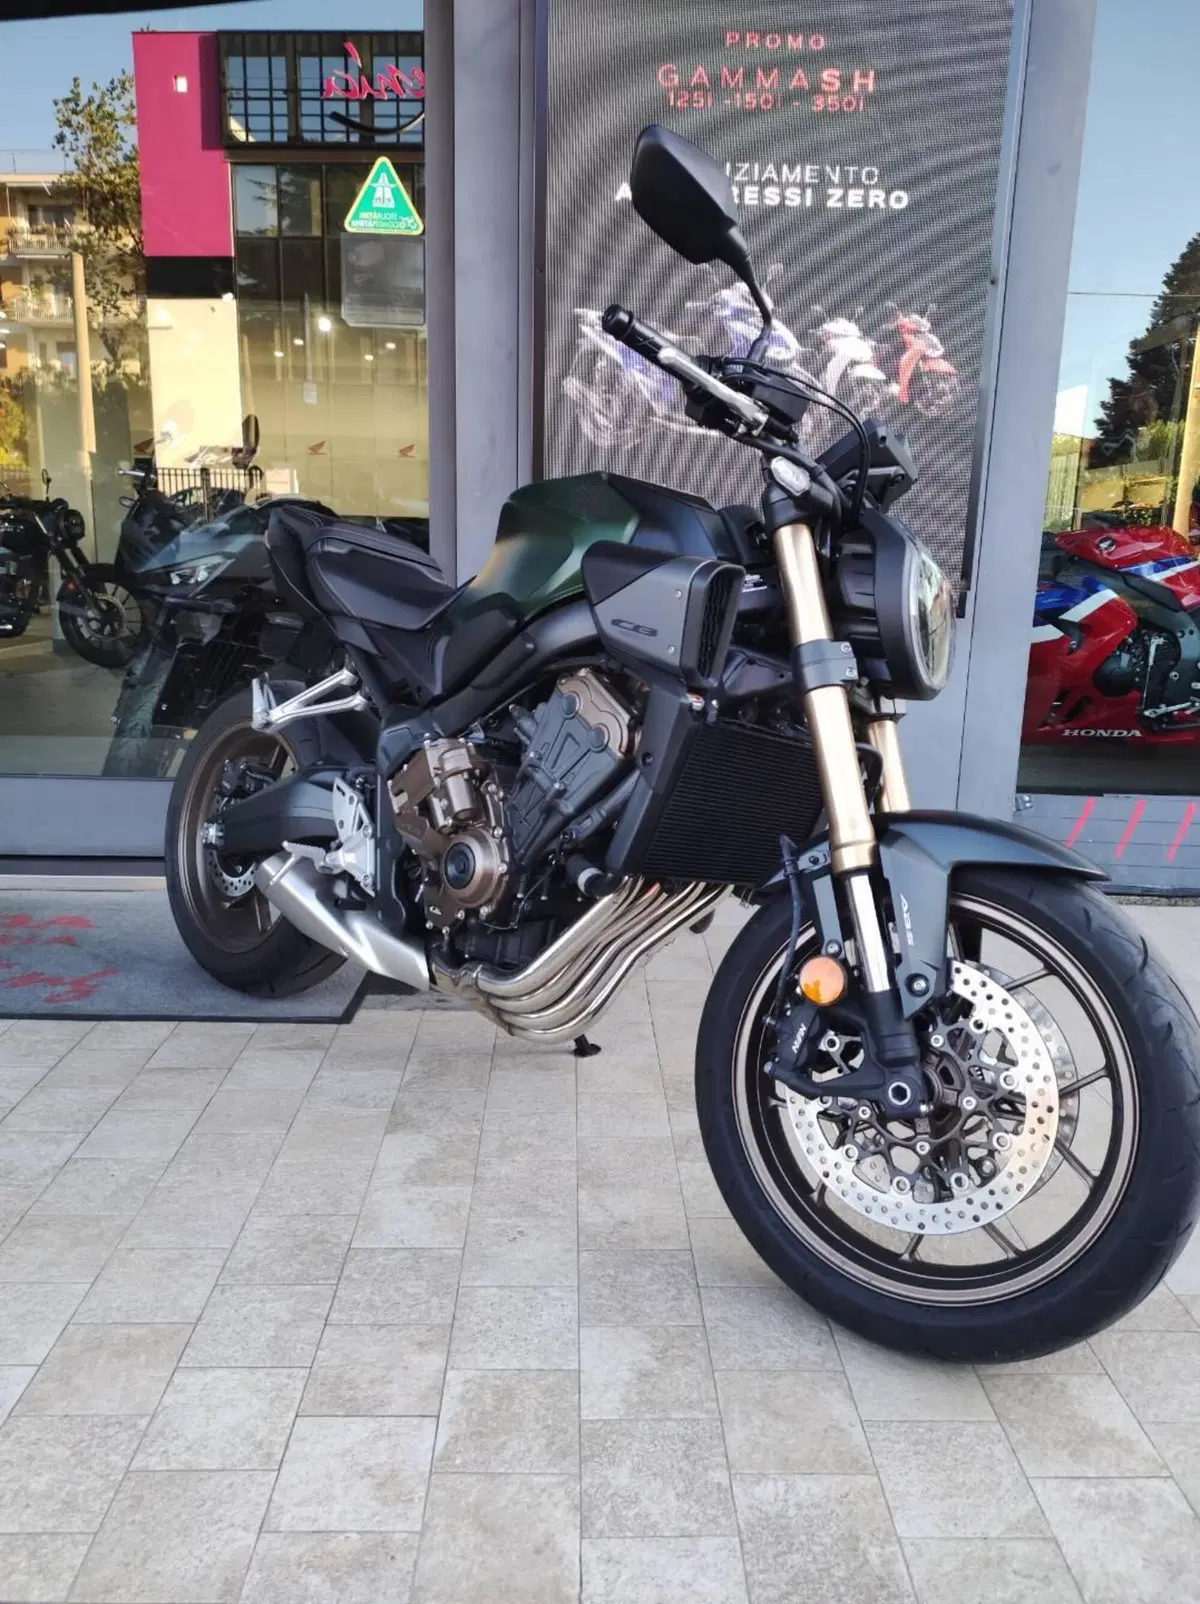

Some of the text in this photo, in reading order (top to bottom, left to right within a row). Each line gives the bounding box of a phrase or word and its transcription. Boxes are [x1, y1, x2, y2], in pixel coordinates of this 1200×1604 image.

[725, 31, 826, 51] PROMO
[658, 64, 876, 93] GAMMASH
[725, 162, 879, 186] ZIAMENTO
[826, 189, 910, 209] ZERO
[1062, 728, 1143, 737] HONDA
[899, 892, 915, 947] ABS
